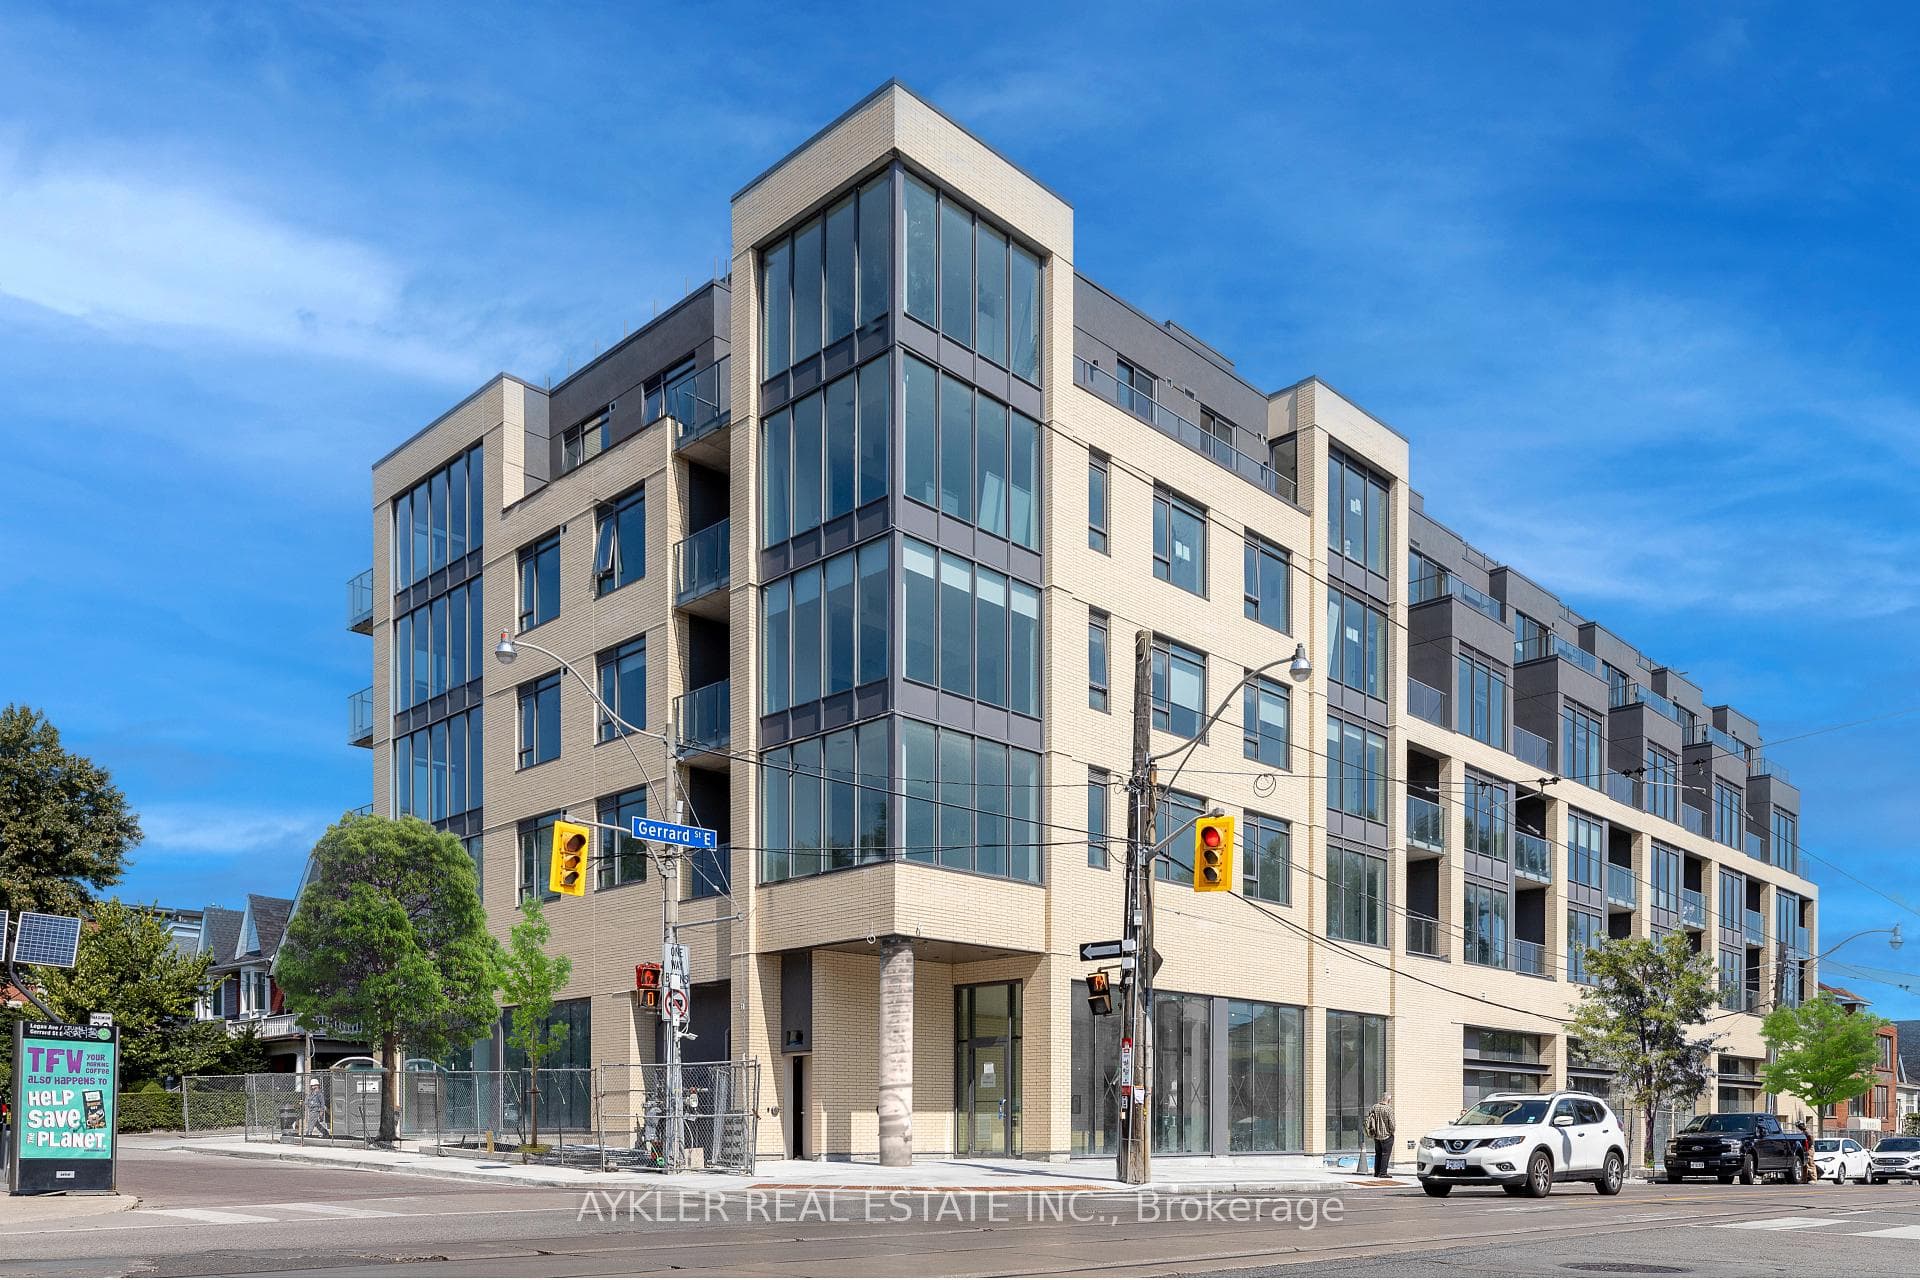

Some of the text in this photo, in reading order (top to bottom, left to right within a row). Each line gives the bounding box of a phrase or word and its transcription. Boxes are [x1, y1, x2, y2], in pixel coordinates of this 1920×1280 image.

[638, 821, 690, 842] Gerrard
[704, 832, 711, 846] E
[671, 946, 683, 957] ONE
[671, 960, 682, 970] WAY
[27, 1047, 84, 1074] TFW
